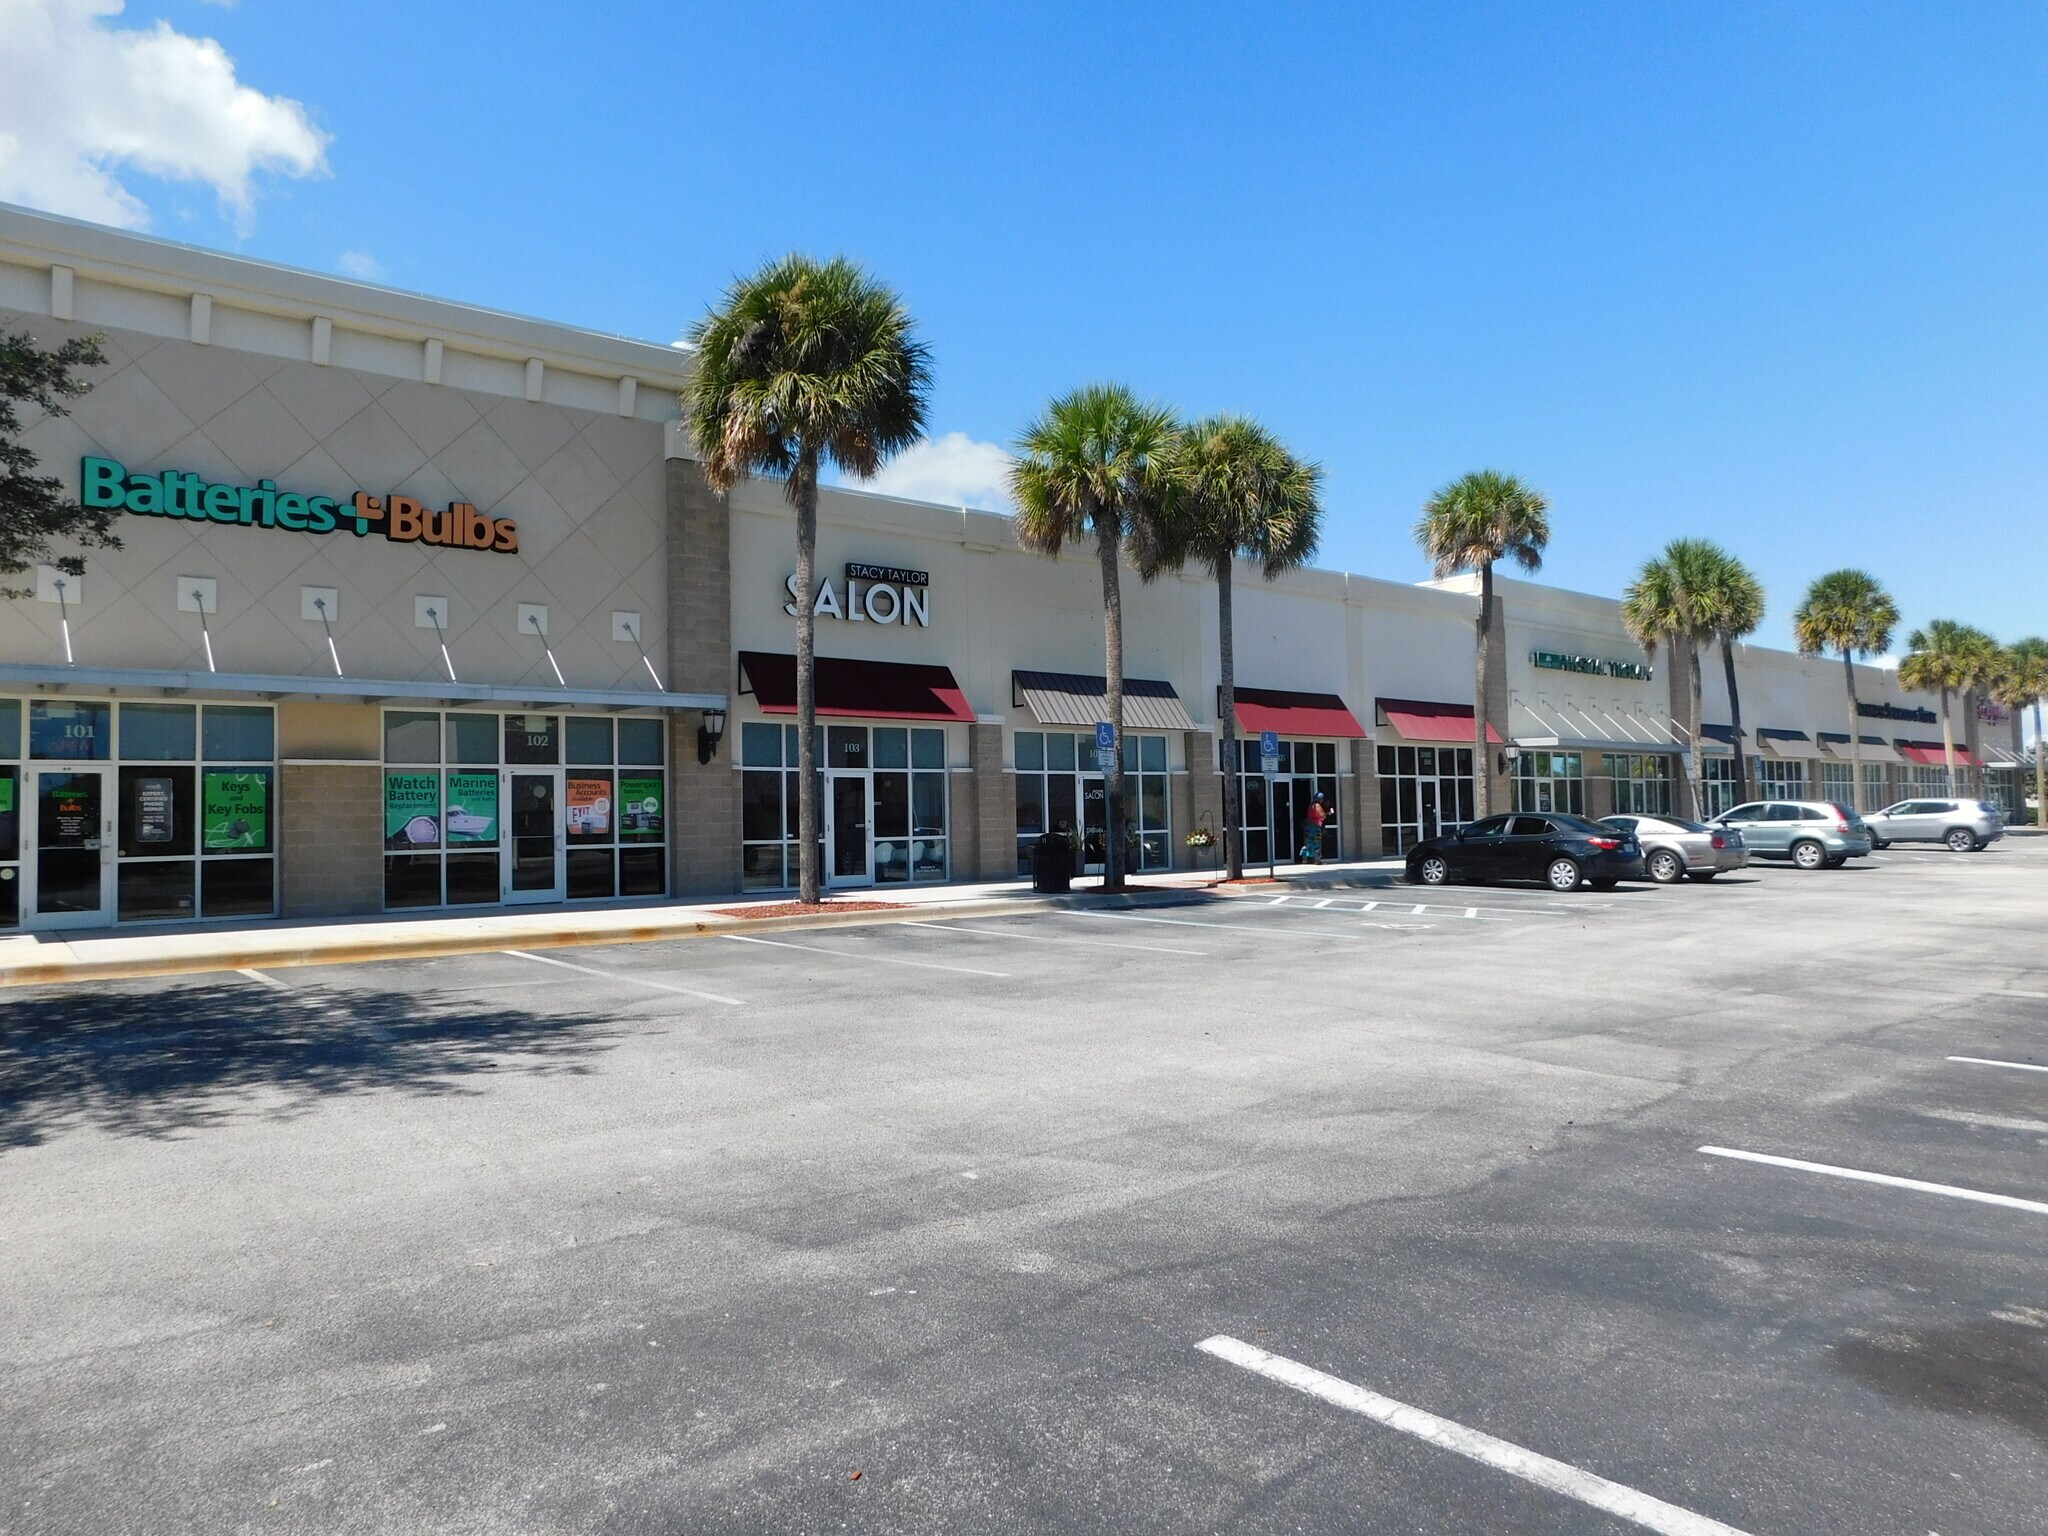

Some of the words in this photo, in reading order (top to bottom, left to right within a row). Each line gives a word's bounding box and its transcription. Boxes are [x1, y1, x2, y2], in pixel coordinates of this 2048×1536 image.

[81, 456, 337, 535] Batteries
[386, 495, 518, 554] Bulbs
[850, 564, 885, 579] STACY
[887, 569, 927, 584] TAYLOR
[783, 573, 930, 628] SALON
[64, 724, 95, 738] 101
[526, 734, 549, 747] 102
[843, 742, 860, 753] 103
[221, 781, 251, 795] Keys
[388, 776, 436, 790] Watch
[449, 777, 496, 788] Marine
[567, 781, 602, 790] Business
[389, 790, 437, 803] Battery
[458, 788, 496, 797] Batteries
[575, 787, 607, 796] Accounts
[1084, 791, 1104, 800] SALON
[208, 804, 232, 817] Key
[235, 803, 264, 814] Fobs
